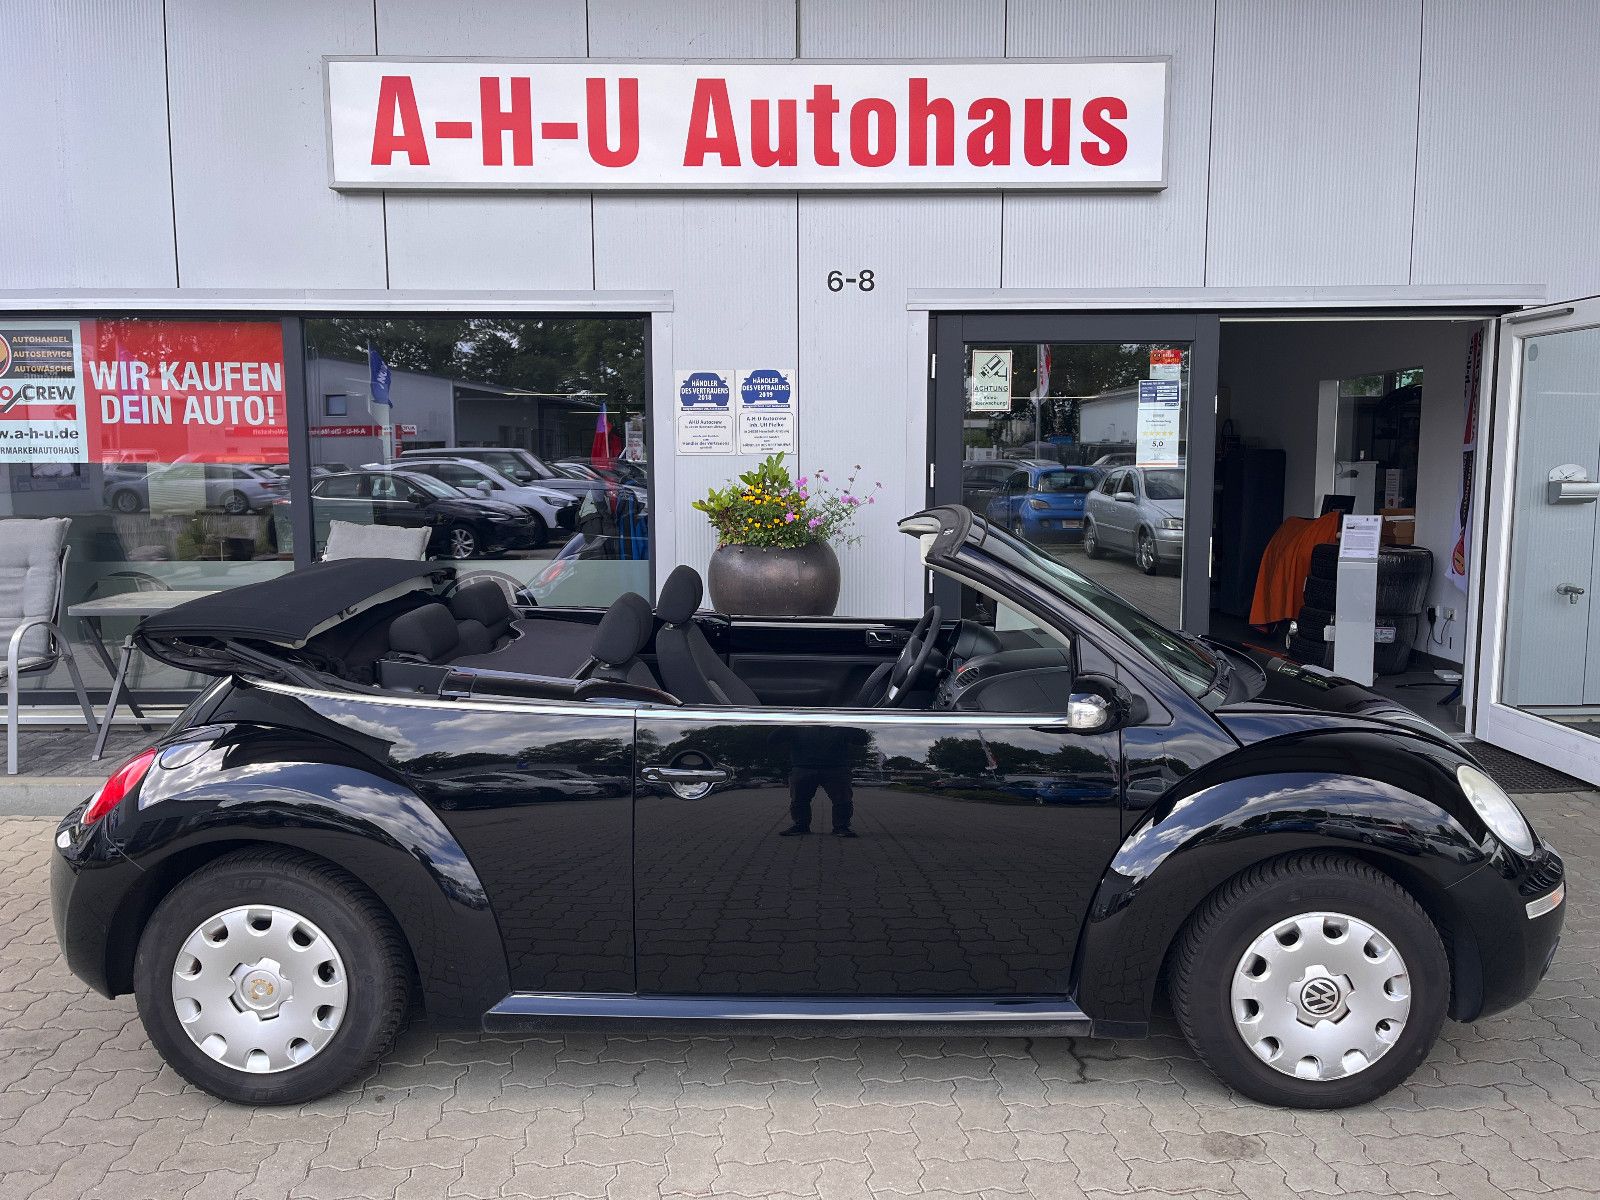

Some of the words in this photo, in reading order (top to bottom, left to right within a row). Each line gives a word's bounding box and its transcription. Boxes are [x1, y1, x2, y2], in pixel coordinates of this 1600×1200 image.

[371, 76, 640, 168] A-H-U
[683, 77, 1128, 168] Autohaus
[827, 269, 875, 292] 6-8
[13, 350, 72, 358] AUTOSERVICE
[88, 360, 151, 391] WIR
[159, 360, 283, 392] KAUFEN
[752, 376, 779, 384] HÄNDLER
[691, 378, 718, 387] HÄNDLER
[681, 387, 692, 395] DES
[692, 387, 729, 395] VERTRAUENS
[101, 394, 173, 425] DEIN
[182, 395, 276, 426] AUTO!
[1151, 440, 1164, 448] 5,0
